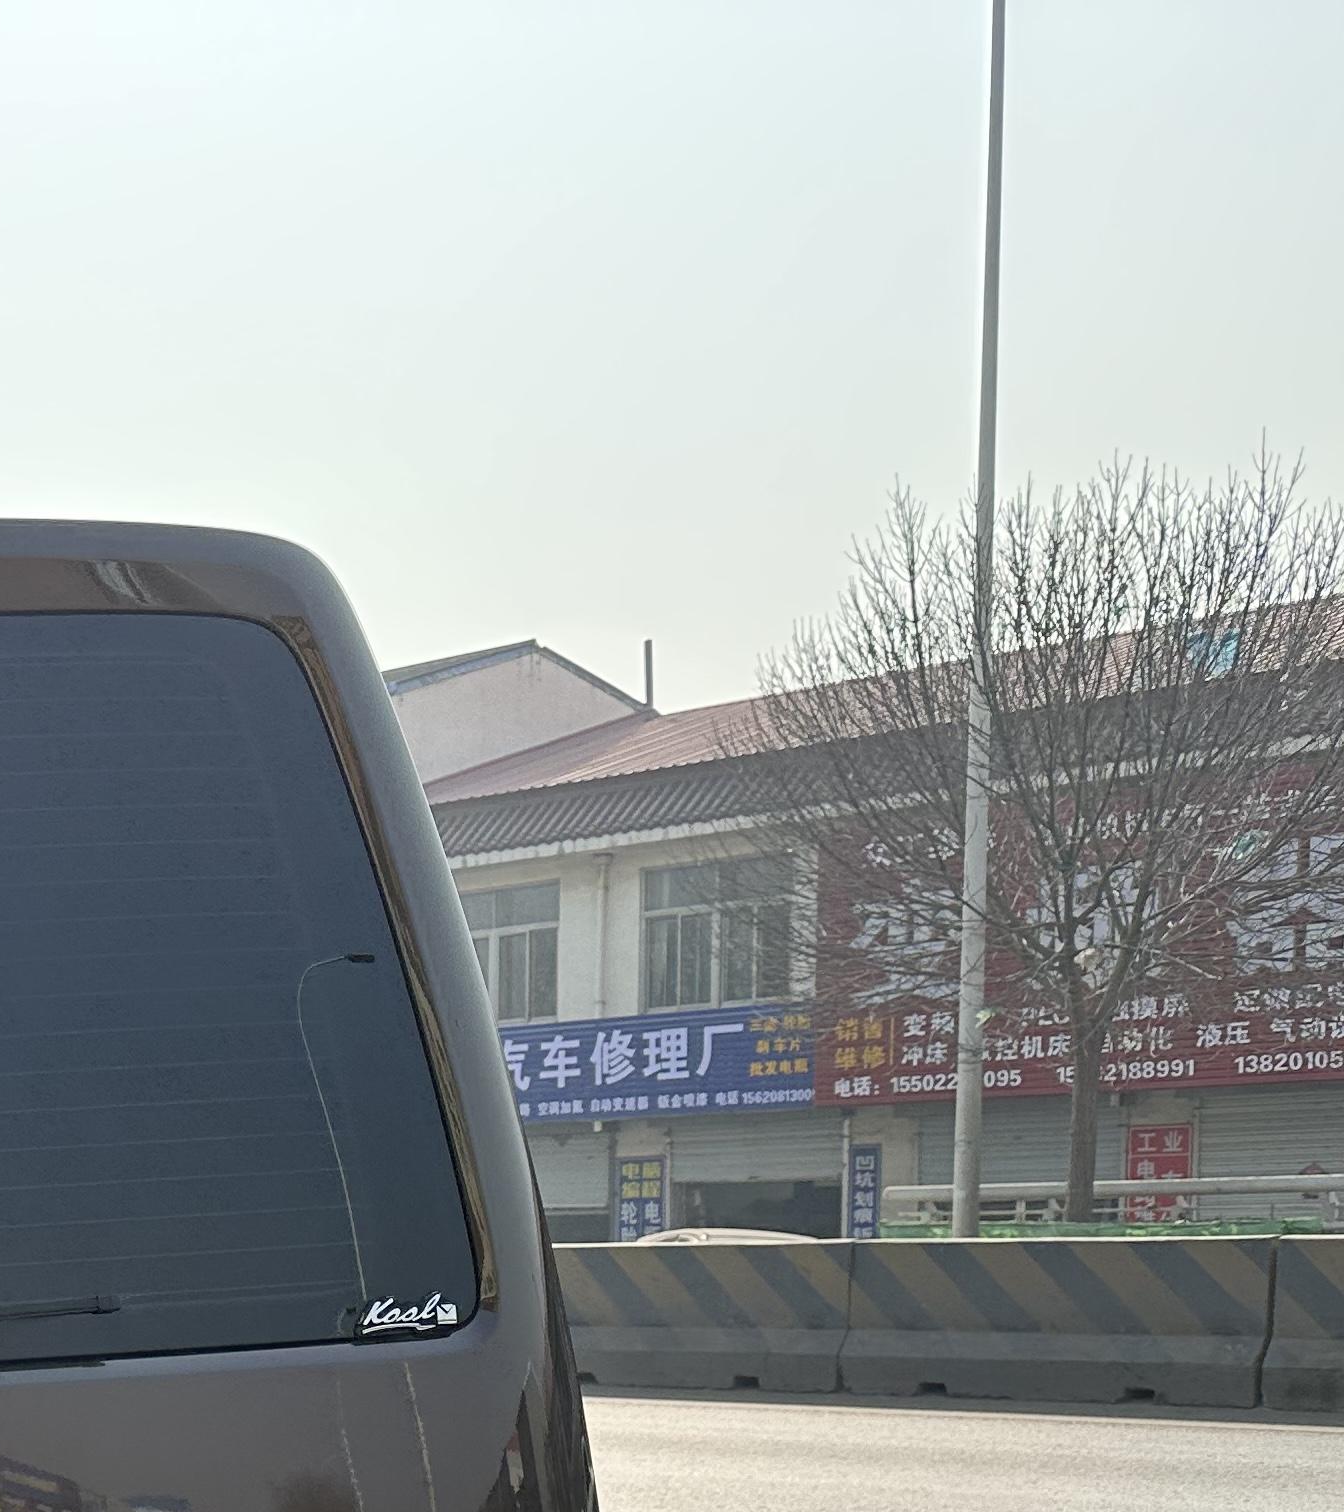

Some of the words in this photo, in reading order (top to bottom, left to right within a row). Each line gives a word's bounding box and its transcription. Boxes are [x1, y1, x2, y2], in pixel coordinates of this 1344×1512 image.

[1196, 1020, 1251, 1048] 液压
[834, 1047, 885, 1070] 维修
[890, 1070, 1022, 1093] 155022095
[1056, 1059, 1195, 1084] 152188991
[1136, 1130, 1184, 1153] 工业
